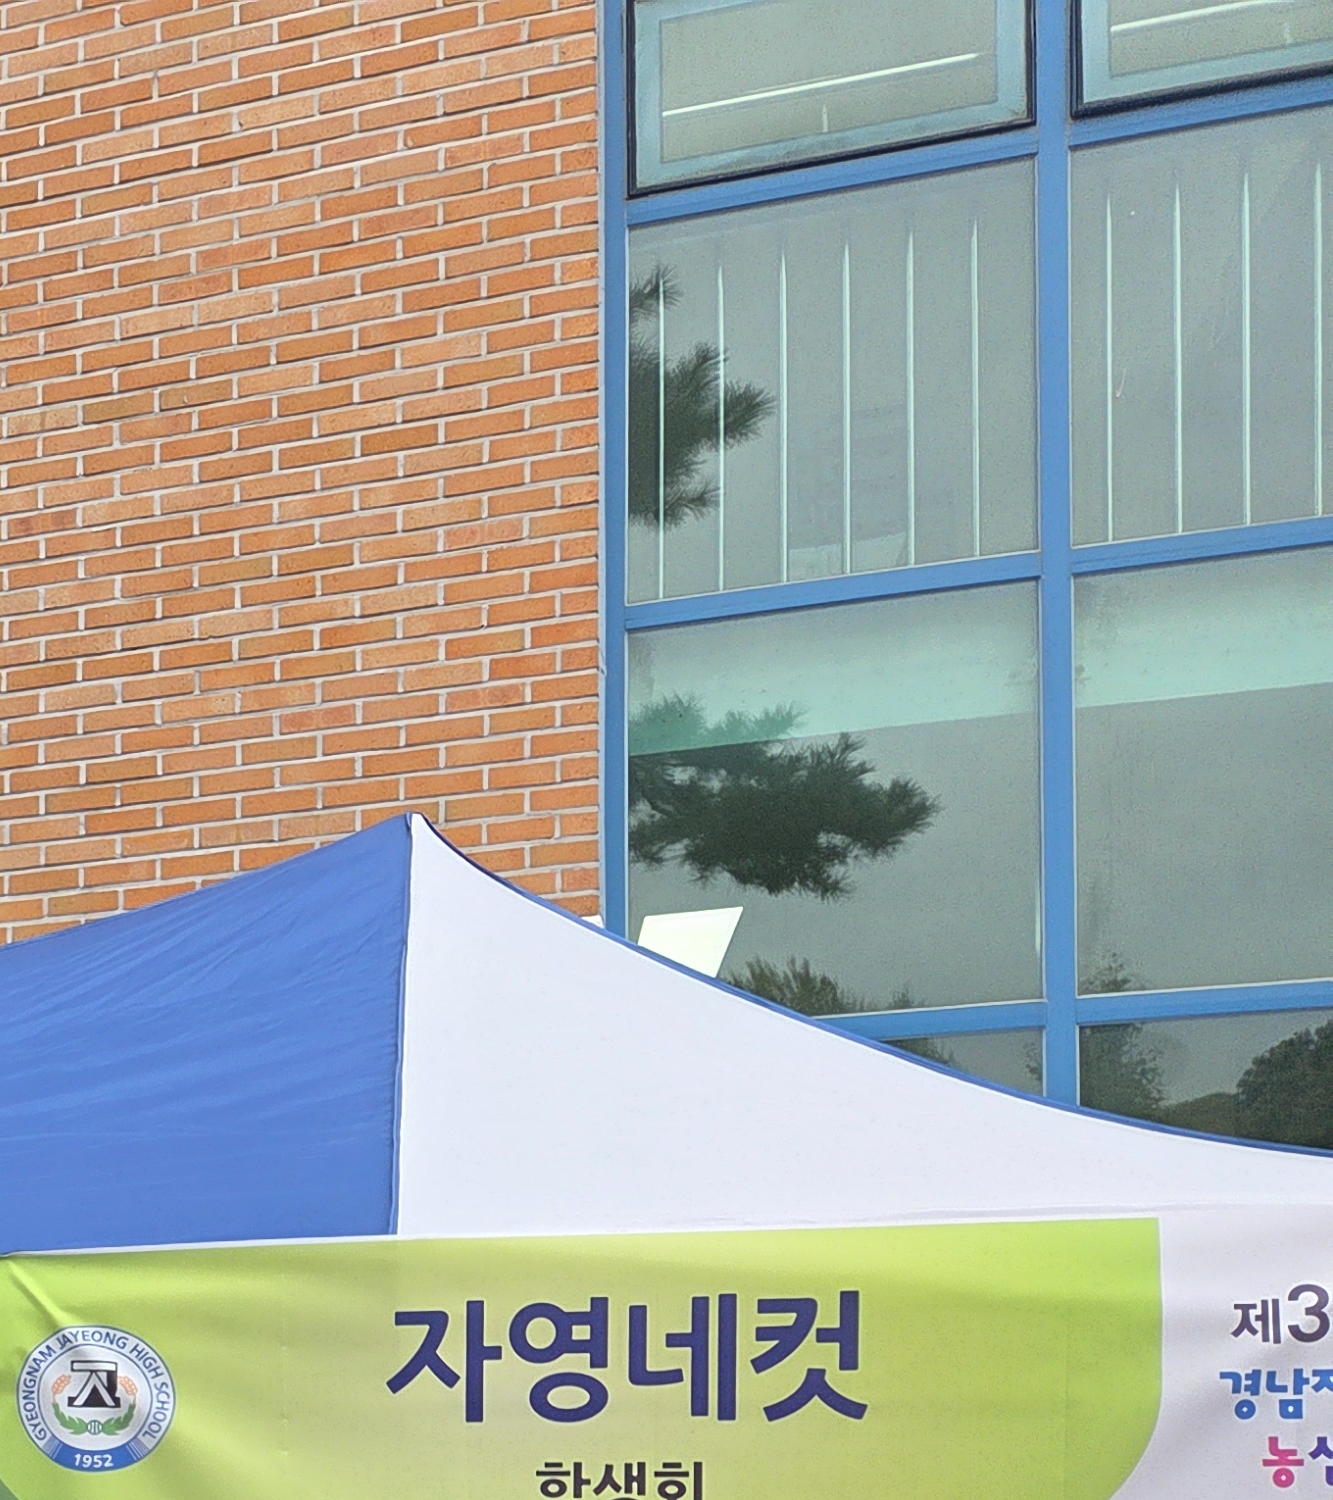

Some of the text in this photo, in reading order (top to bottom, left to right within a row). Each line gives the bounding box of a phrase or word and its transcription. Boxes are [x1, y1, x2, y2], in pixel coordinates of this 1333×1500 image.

[386, 1290, 868, 1423] 자영네컷
[1231, 1284, 1333, 1344] 제3
[21, 1330, 171, 1442] GYEONGNAM JAYEONG HIGH SCHOOL
[74, 1453, 114, 1468] 1952
